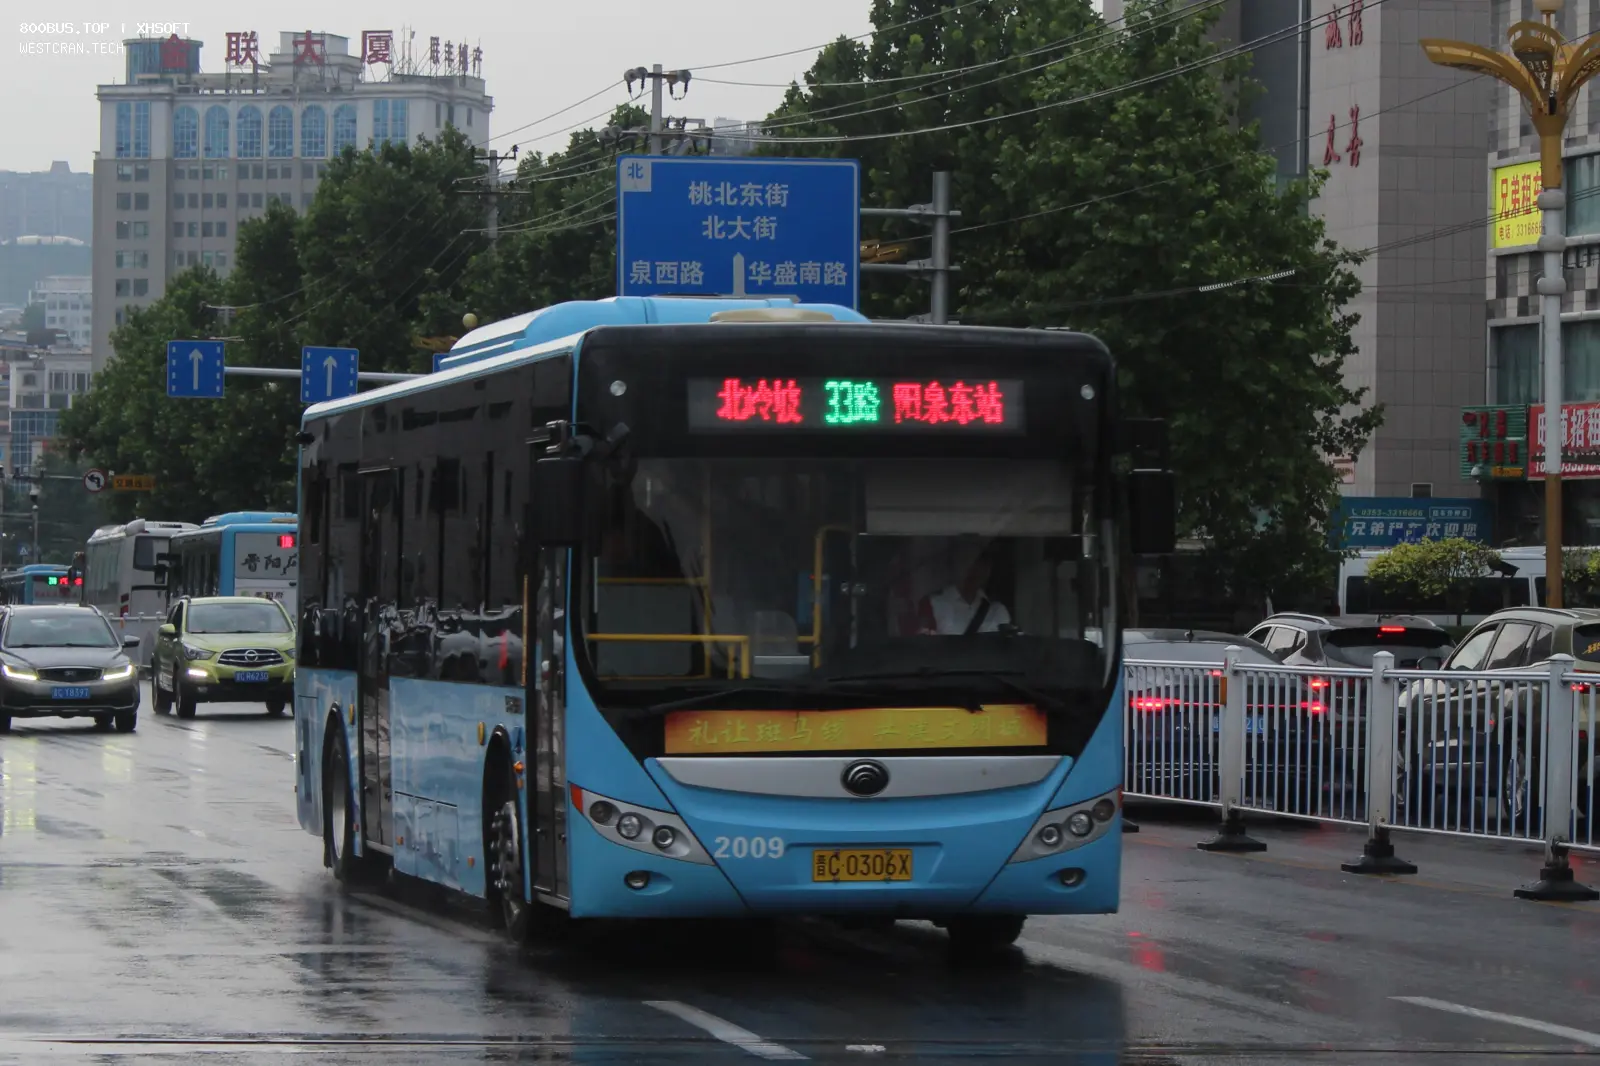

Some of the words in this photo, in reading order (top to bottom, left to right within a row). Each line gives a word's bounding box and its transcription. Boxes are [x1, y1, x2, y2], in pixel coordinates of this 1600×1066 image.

[627, 162, 644, 180] 北
[688, 181, 789, 208] 桃北东街
[702, 215, 778, 240] 北大街
[629, 260, 705, 285] 泉西路
[748, 260, 848, 286] 华盛南路
[893, 380, 1004, 424] 阳泉东站
[688, 718, 848, 744] 礼让斑马线
[714, 836, 785, 859] 2009
